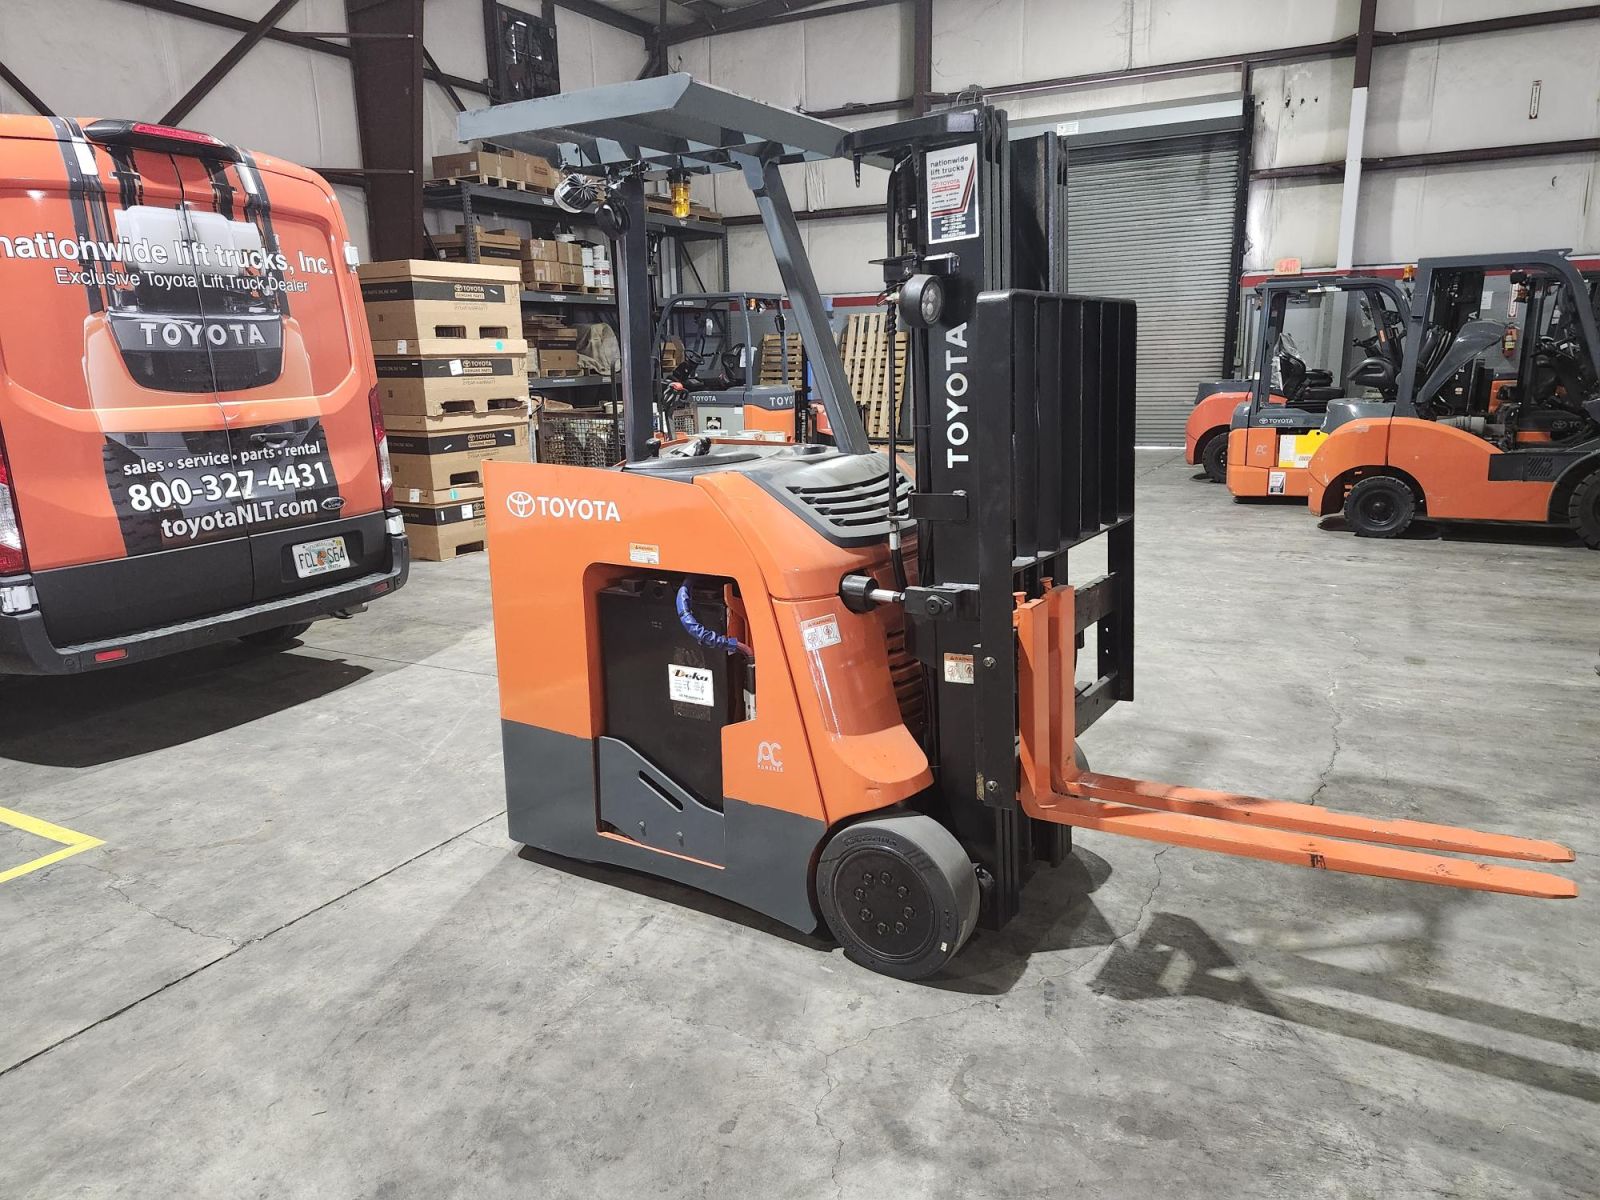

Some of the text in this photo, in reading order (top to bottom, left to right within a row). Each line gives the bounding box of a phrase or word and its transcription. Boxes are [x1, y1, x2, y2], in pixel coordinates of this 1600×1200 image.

[931, 155, 969, 168] nationwide
[931, 165, 964, 176] lift trucks
[0, 231, 333, 275] nationwide lift trucks, Inc.
[54, 267, 308, 292] Exclusive Toyota Lift Truck Dealer
[140, 322, 266, 346] TOYOTA
[945, 321, 969, 469] TOYOTA
[123, 441, 321, 476] sales service parts rental
[128, 461, 330, 512] 800-327-4431
[161, 498, 318, 539] toyotaNLT.com
[536, 496, 621, 522] TOYOTA
[298, 552, 317, 570] FCL
